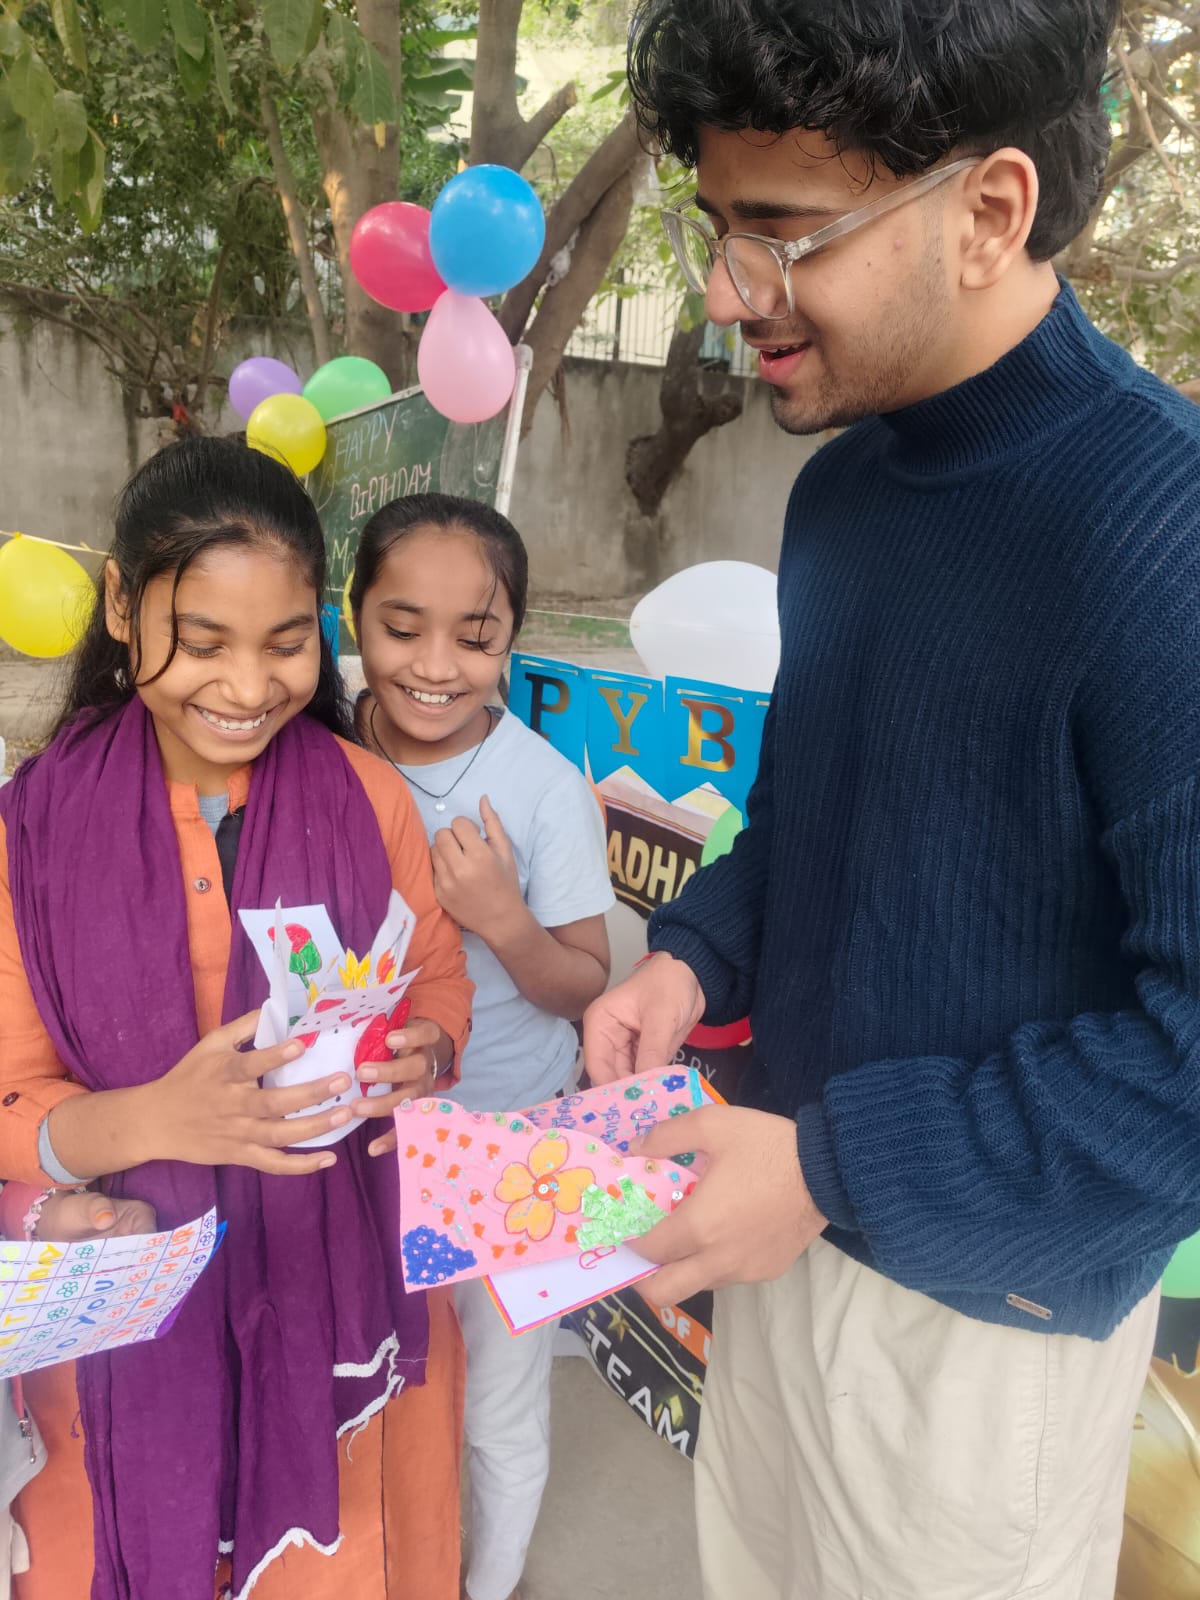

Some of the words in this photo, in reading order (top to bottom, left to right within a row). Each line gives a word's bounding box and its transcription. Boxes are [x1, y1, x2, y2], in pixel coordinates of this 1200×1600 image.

[334, 403, 401, 471] HAPPY
[349, 461, 432, 521] BIRTHDAY
[660, 1306, 692, 1340] OF
[583, 1319, 691, 1456] TEAM
